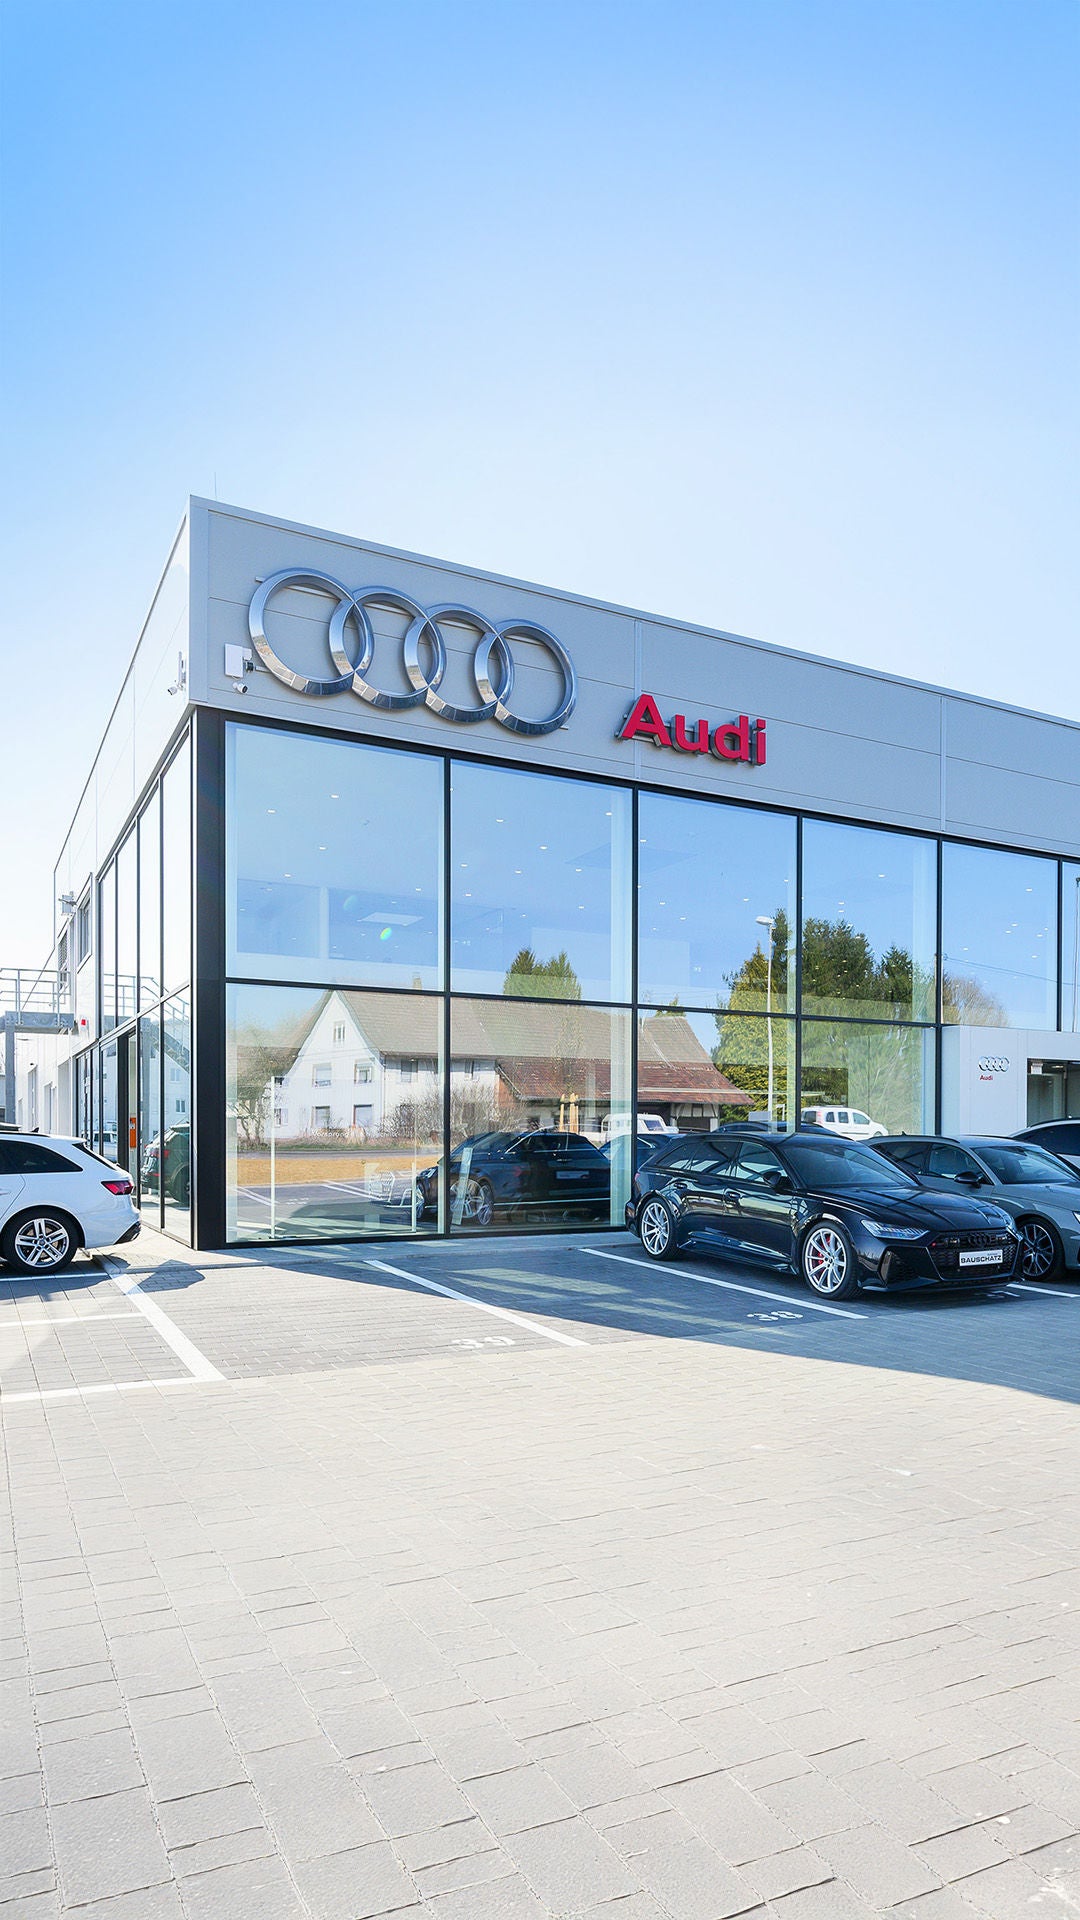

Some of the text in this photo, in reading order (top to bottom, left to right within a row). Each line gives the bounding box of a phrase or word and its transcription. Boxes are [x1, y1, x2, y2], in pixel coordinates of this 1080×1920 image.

[620, 693, 766, 766] Audi
[960, 1254, 1002, 1264] BAUSCHATZ
[746, 1310, 804, 1321] 38
[451, 1336, 515, 1350] 39
